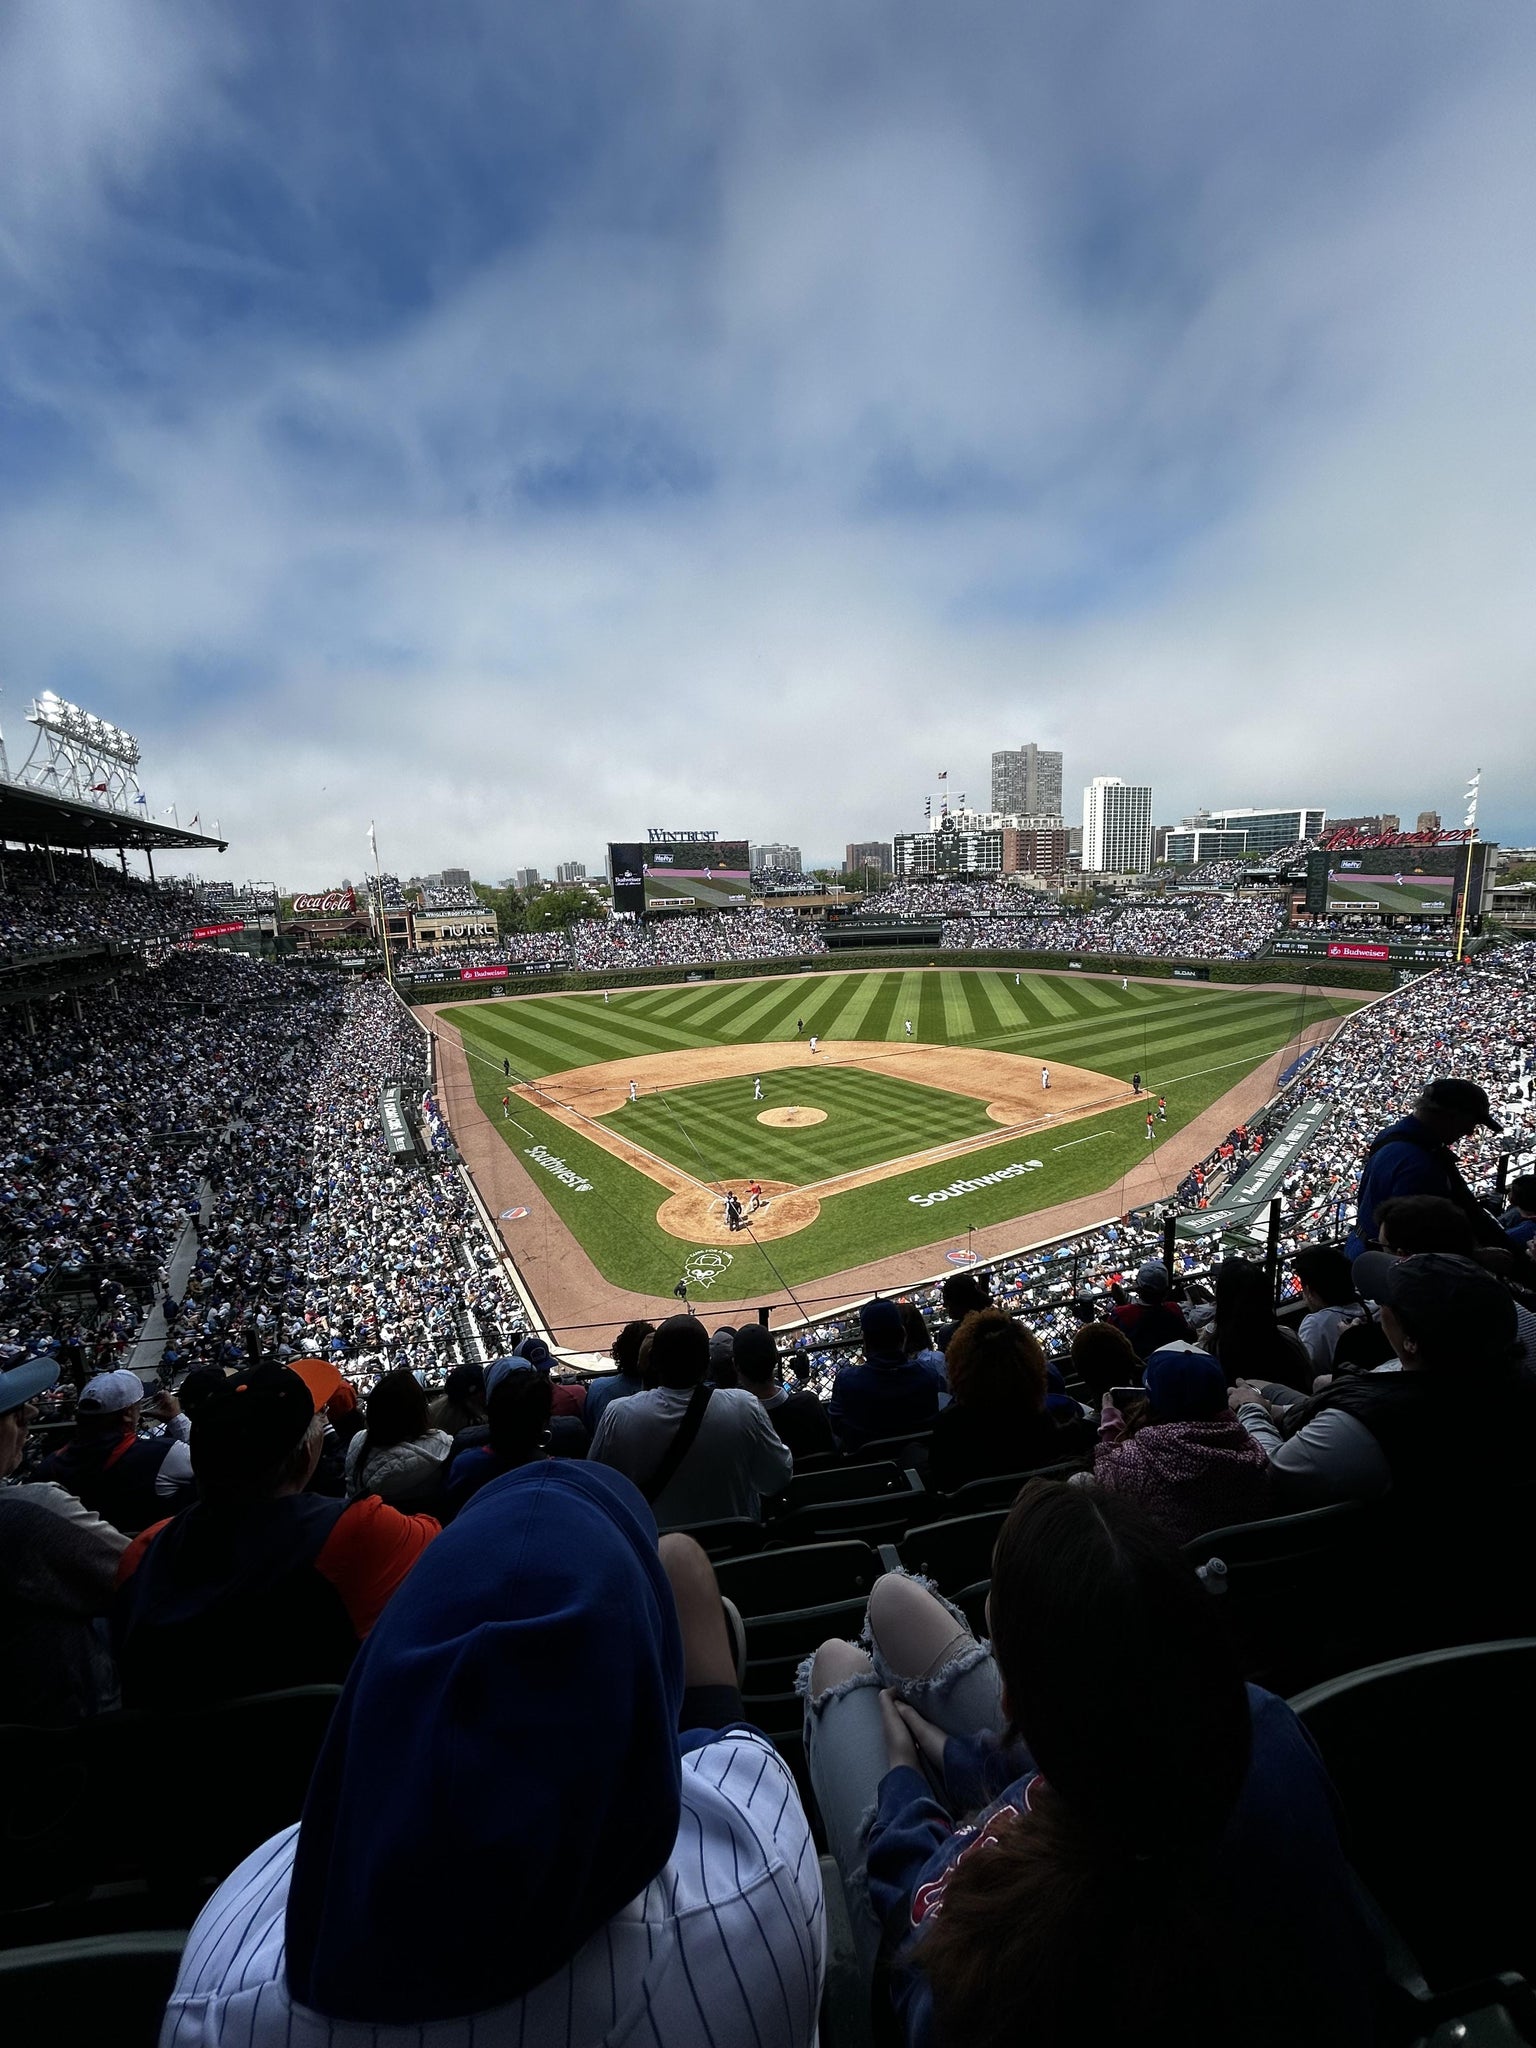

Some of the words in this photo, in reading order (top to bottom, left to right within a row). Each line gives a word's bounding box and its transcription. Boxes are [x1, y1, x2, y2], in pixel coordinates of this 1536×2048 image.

[647, 829, 718, 841] WINTRUST
[1319, 825, 1479, 849] Budweiser
[1310, 857, 1326, 907] CHICAGO
[293, 892, 352, 912] Coca-Cola
[1343, 947, 1386, 957] Budweiser
[474, 968, 507, 978] Budweiser
[1174, 969, 1196, 977] SLOAN
[524, 1145, 588, 1191] Southwest
[908, 1162, 1035, 1207] Southwest
